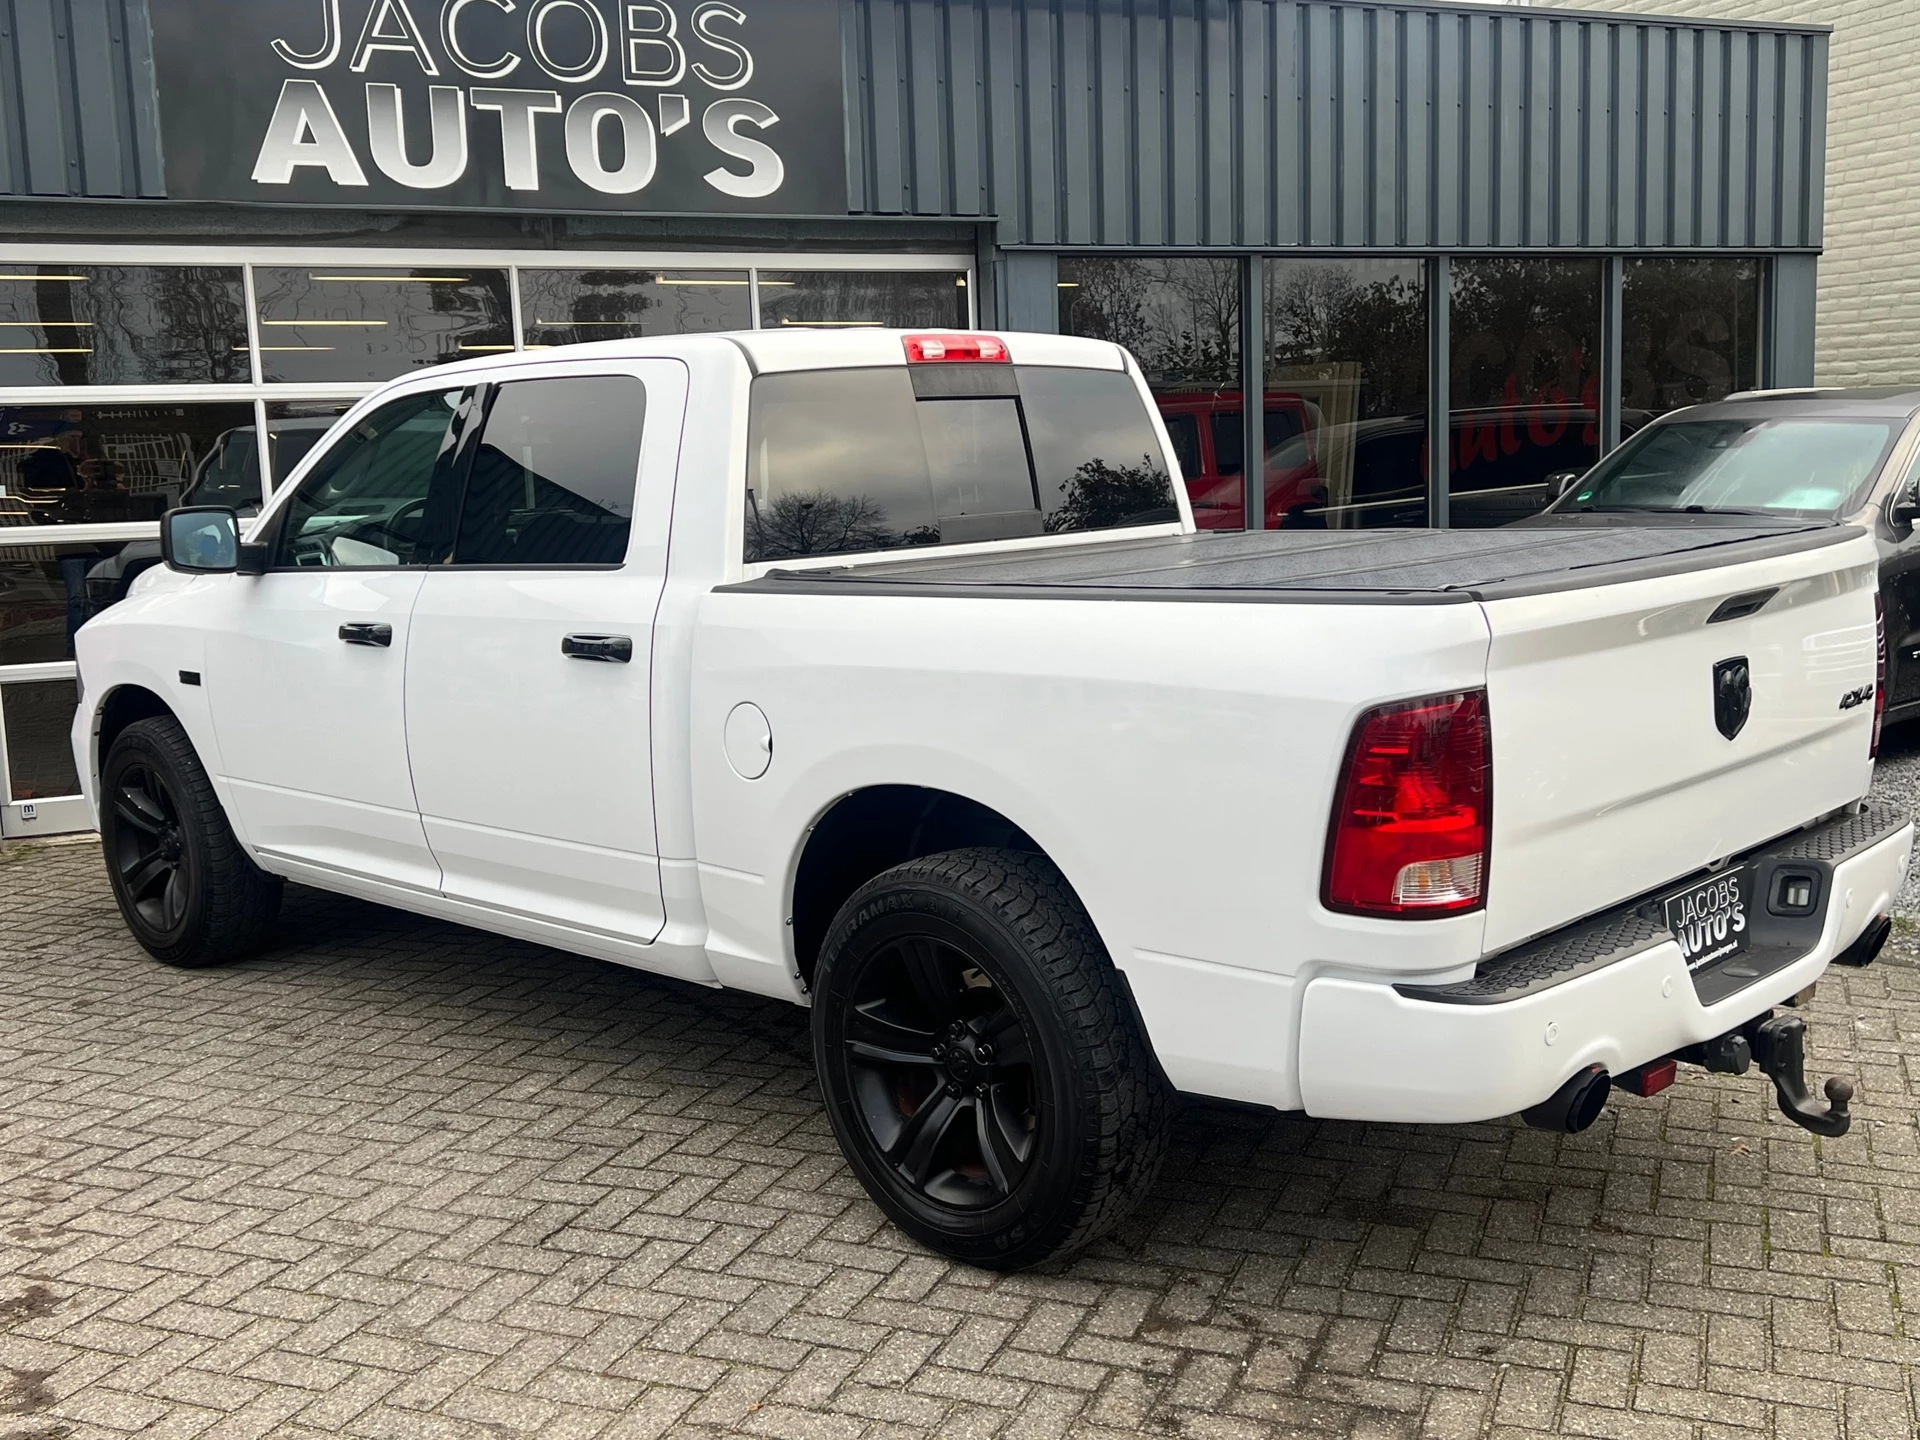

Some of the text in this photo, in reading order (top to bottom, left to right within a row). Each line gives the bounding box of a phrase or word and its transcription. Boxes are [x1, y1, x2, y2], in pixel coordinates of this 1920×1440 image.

[271, 0, 754, 91] JACOBS
[251, 79, 785, 198] AUTO'S
[824, 893, 967, 973] TERRAMAX A/T
[1676, 876, 1740, 928] JACOBS
[1678, 901, 1746, 958] AUTO'S
